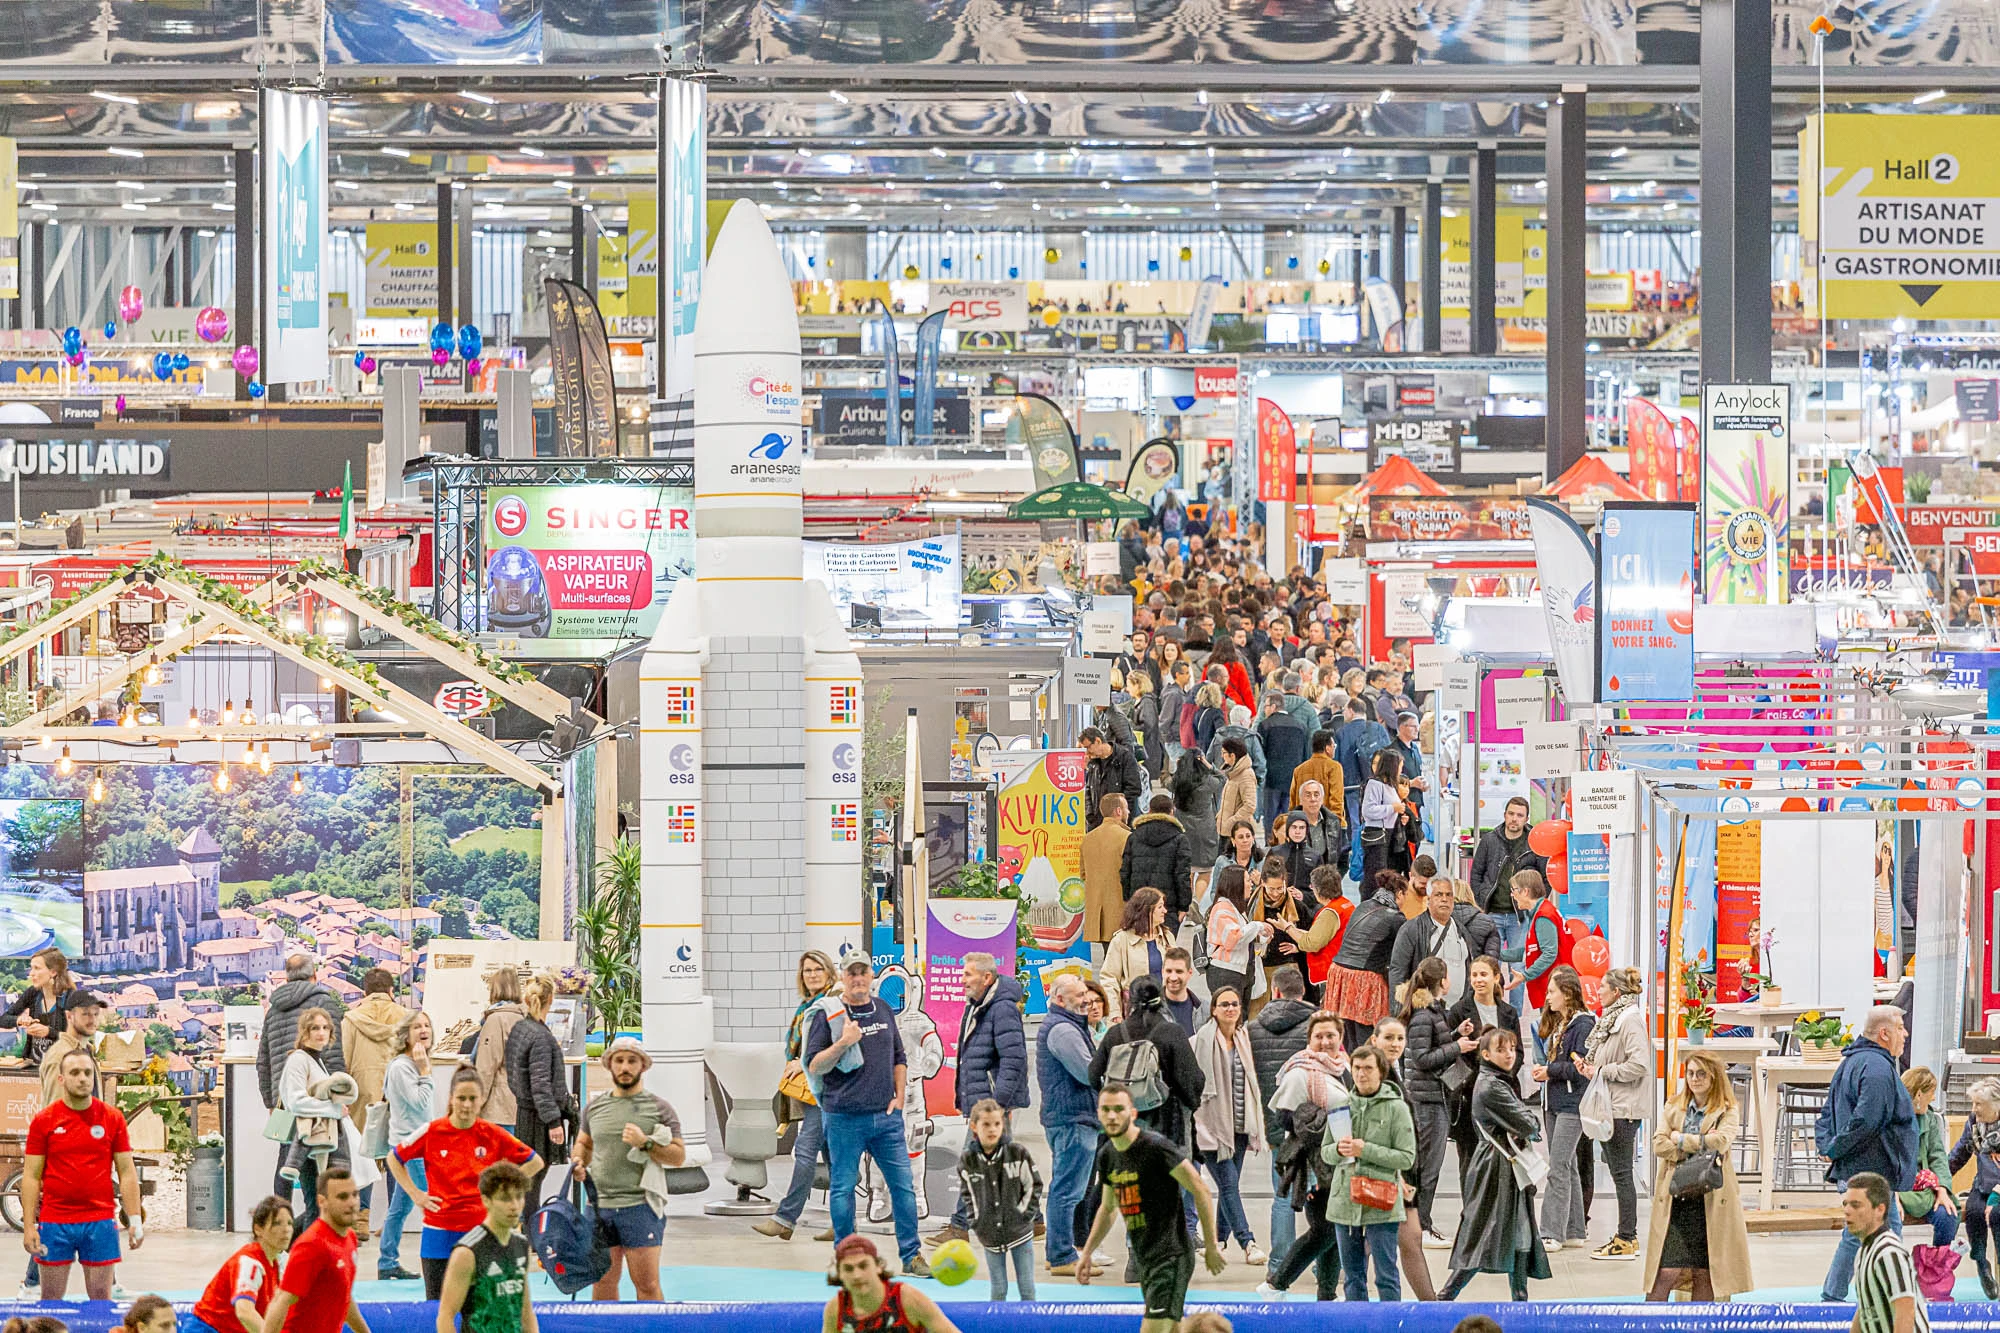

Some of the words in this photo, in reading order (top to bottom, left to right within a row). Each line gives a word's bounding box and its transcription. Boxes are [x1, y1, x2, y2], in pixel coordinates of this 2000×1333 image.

[1885, 159, 1929, 179] Hall
[1934, 158, 1951, 180] 2
[1858, 203, 1986, 221] ARTISANAT
[1859, 227, 1889, 245] DU
[1898, 227, 1984, 246] MONDE
[395, 244, 416, 254] Hall
[418, 243, 427, 255] 5
[390, 269, 434, 278] HABITAT
[637, 263, 656, 273] AM
[381, 283, 438, 292] CHAUFFAG
[938, 285, 1016, 297] Alarmes
[373, 297, 438, 306] CLIMATISATI
[949, 300, 1002, 317] ACS
[766, 394, 800, 408] l'espac
[1715, 389, 1781, 413] Anylock
[64, 408, 100, 418] France
[840, 405, 886, 422] Arthu
[1375, 422, 1421, 440] MHD
[547, 507, 690, 530] SINGER
[1394, 511, 1461, 520] PROSCIUTTO
[1494, 511, 1530, 520] PROSC
[1911, 511, 1996, 526] BENVENUTI
[1418, 523, 1450, 532] PARMA
[1742, 537, 1759, 545] VIE
[545, 555, 647, 571] ASPIRATEUR
[1612, 554, 1640, 581] ICI
[563, 574, 628, 590] VAPEUR
[561, 592, 631, 604] Multi-surfaces
[557, 616, 596, 625] Système
[598, 616, 639, 624] VENTURI
[1611, 620, 1653, 631] DONNEZ
[1612, 637, 1644, 648] VOTRE
[1648, 637, 1677, 648] SANG.
[1946, 669, 1981, 683] ETIT
[670, 772, 694, 784] esa
[832, 772, 856, 783] esa
[998, 793, 1081, 835] KIVIKS
[931, 954, 956, 966] Drôle
[670, 964, 697, 973] cnes
